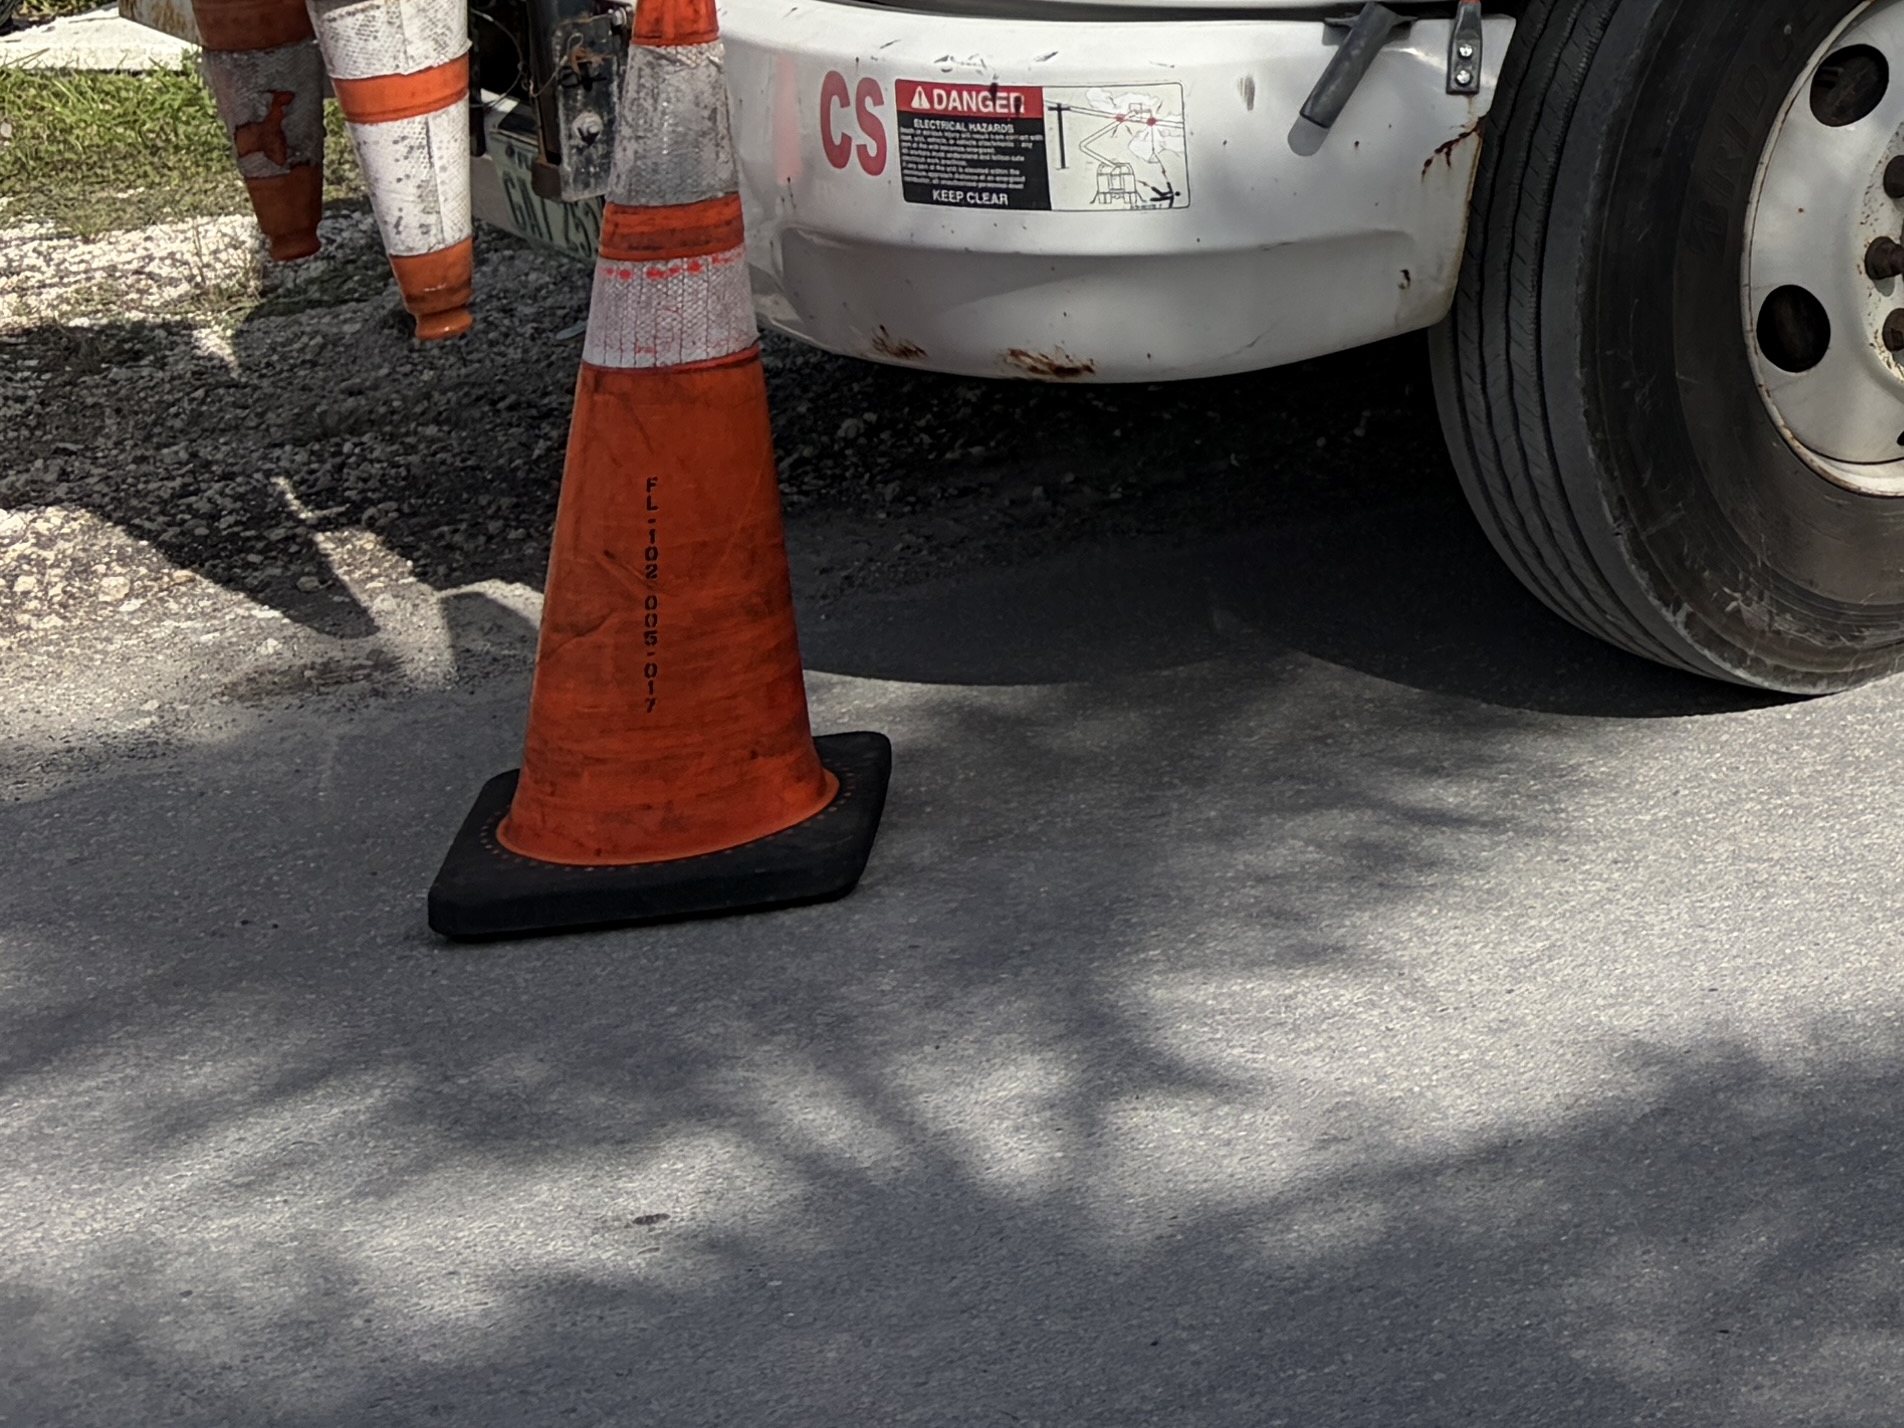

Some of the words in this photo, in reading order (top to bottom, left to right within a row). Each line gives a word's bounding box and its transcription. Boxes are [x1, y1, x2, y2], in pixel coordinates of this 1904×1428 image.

[932, 88, 1026, 114] DANGER
[820, 70, 888, 177] CS
[913, 118, 967, 132] ELECTRICAL
[968, 122, 1015, 135] HAZARDS
[932, 189, 964, 202] KEEP
[966, 191, 1009, 206] CLEAR
